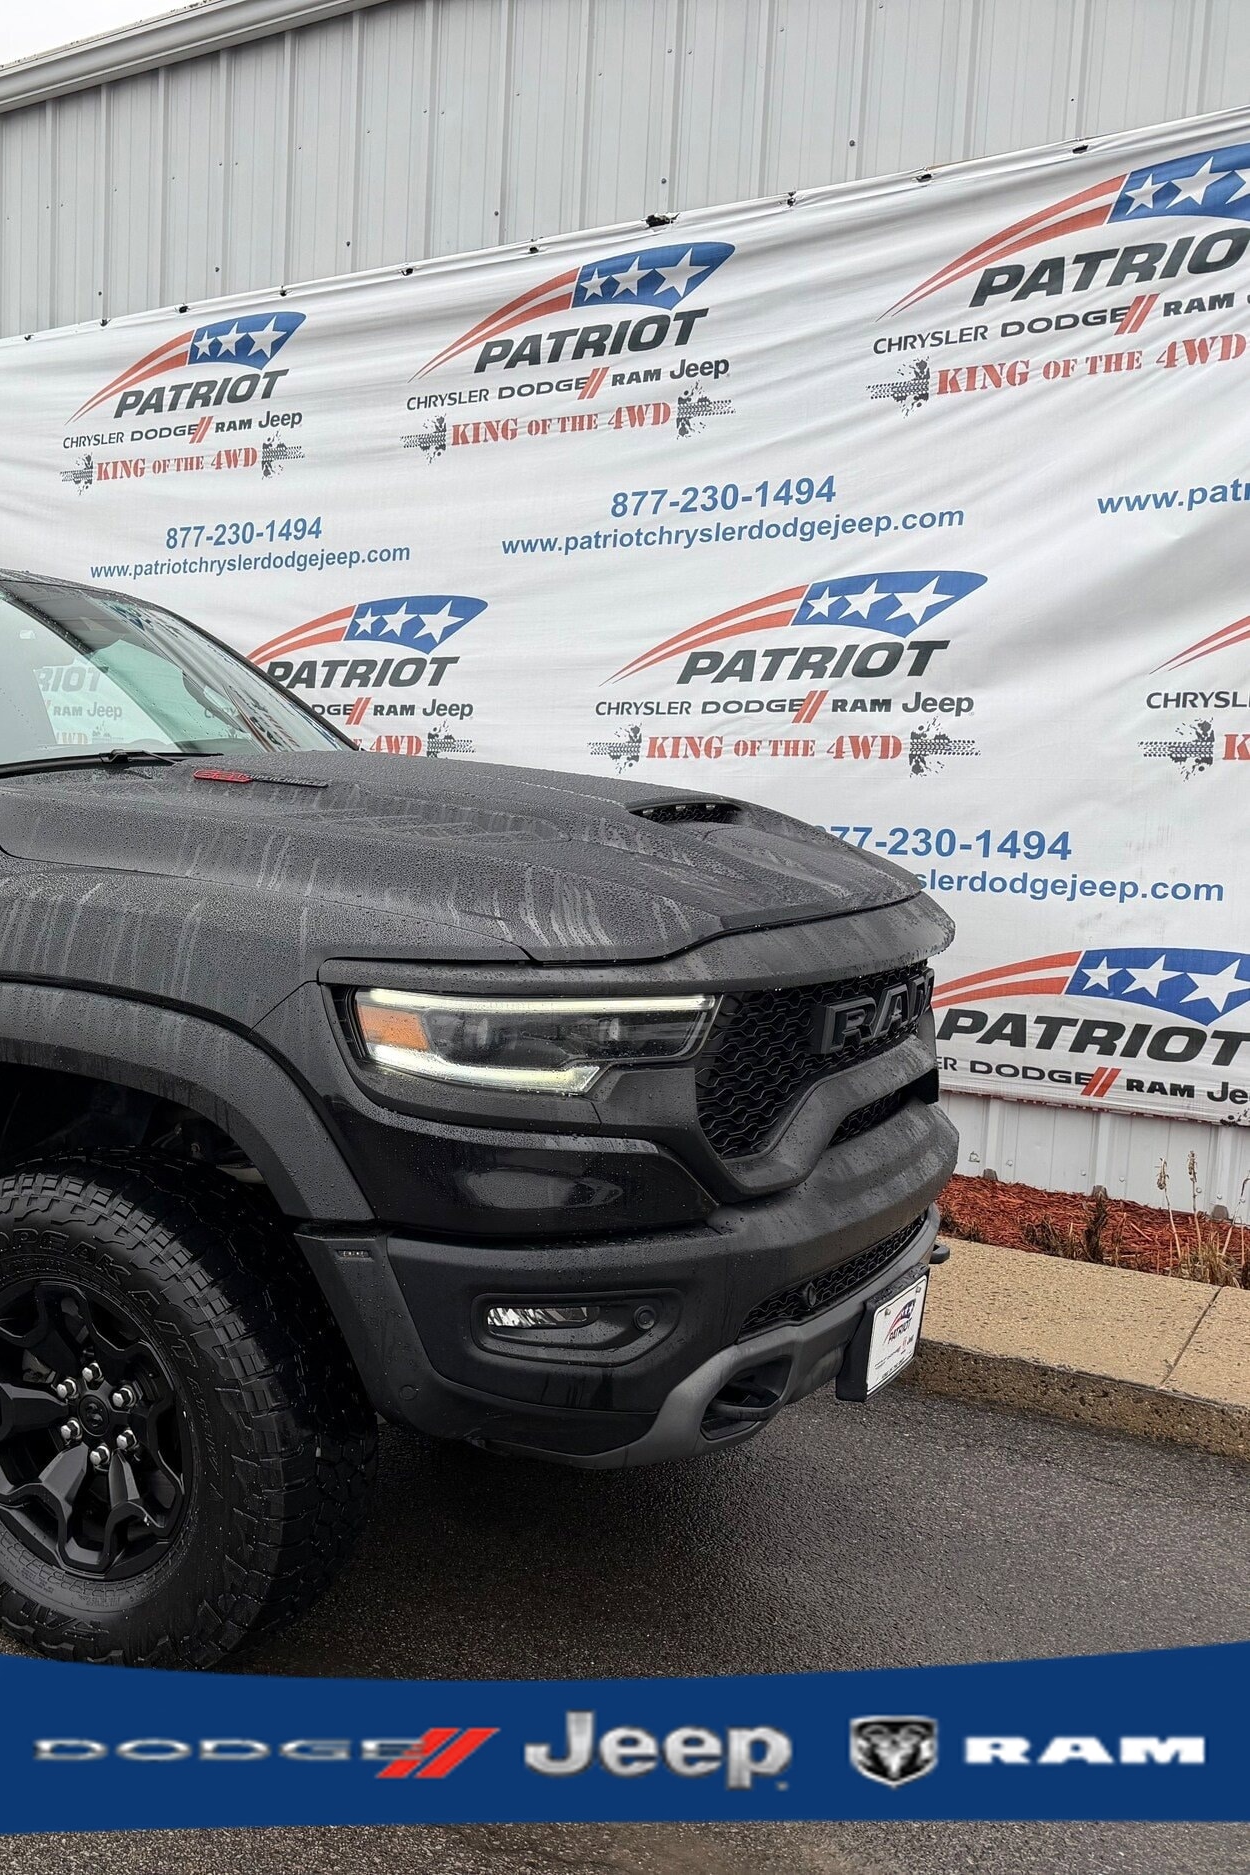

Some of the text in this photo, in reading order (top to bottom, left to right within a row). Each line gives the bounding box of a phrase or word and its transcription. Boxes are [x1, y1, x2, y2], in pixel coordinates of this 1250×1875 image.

[474, 308, 708, 374] PATRIOT
[873, 293, 1234, 355] CHRYSLER DODGE RAM
[407, 358, 730, 411] CHRYSLER DODGE RAM Jeep
[937, 334, 1246, 395] KING OF THE 4WD
[113, 369, 289, 419] PATRIOT
[63, 409, 303, 450] CHRYSLER DODGE RAM Jeep
[451, 402, 671, 446] KING OF THE 4WD
[96, 447, 258, 481] KING OF THE 4WD
[611, 475, 836, 518] 877-230-1494
[166, 517, 323, 550] 877-230-1494
[502, 505, 965, 557] www.patriotchryslerdodgejeep.com
[90, 540, 411, 580] www.patriotchryslerdodgejeep.com
[36, 666, 101, 692] RIOT
[266, 656, 459, 689] PATRIOT
[677, 640, 950, 685] PATRIOT
[87, 701, 123, 720] Jeep
[373, 703, 416, 717] RAM
[423, 698, 473, 720] Jeep
[595, 692, 975, 716] CHRYSLER DODGE RAM Jeep
[646, 735, 902, 760] KING OF THE 4WD
[814, 825, 1071, 861] 77-230-1494
[936, 1009, 1250, 1066] PATRIOT
[970, 1061, 1094, 1085] DODGE
[1126, 1078, 1195, 1098] RAM
